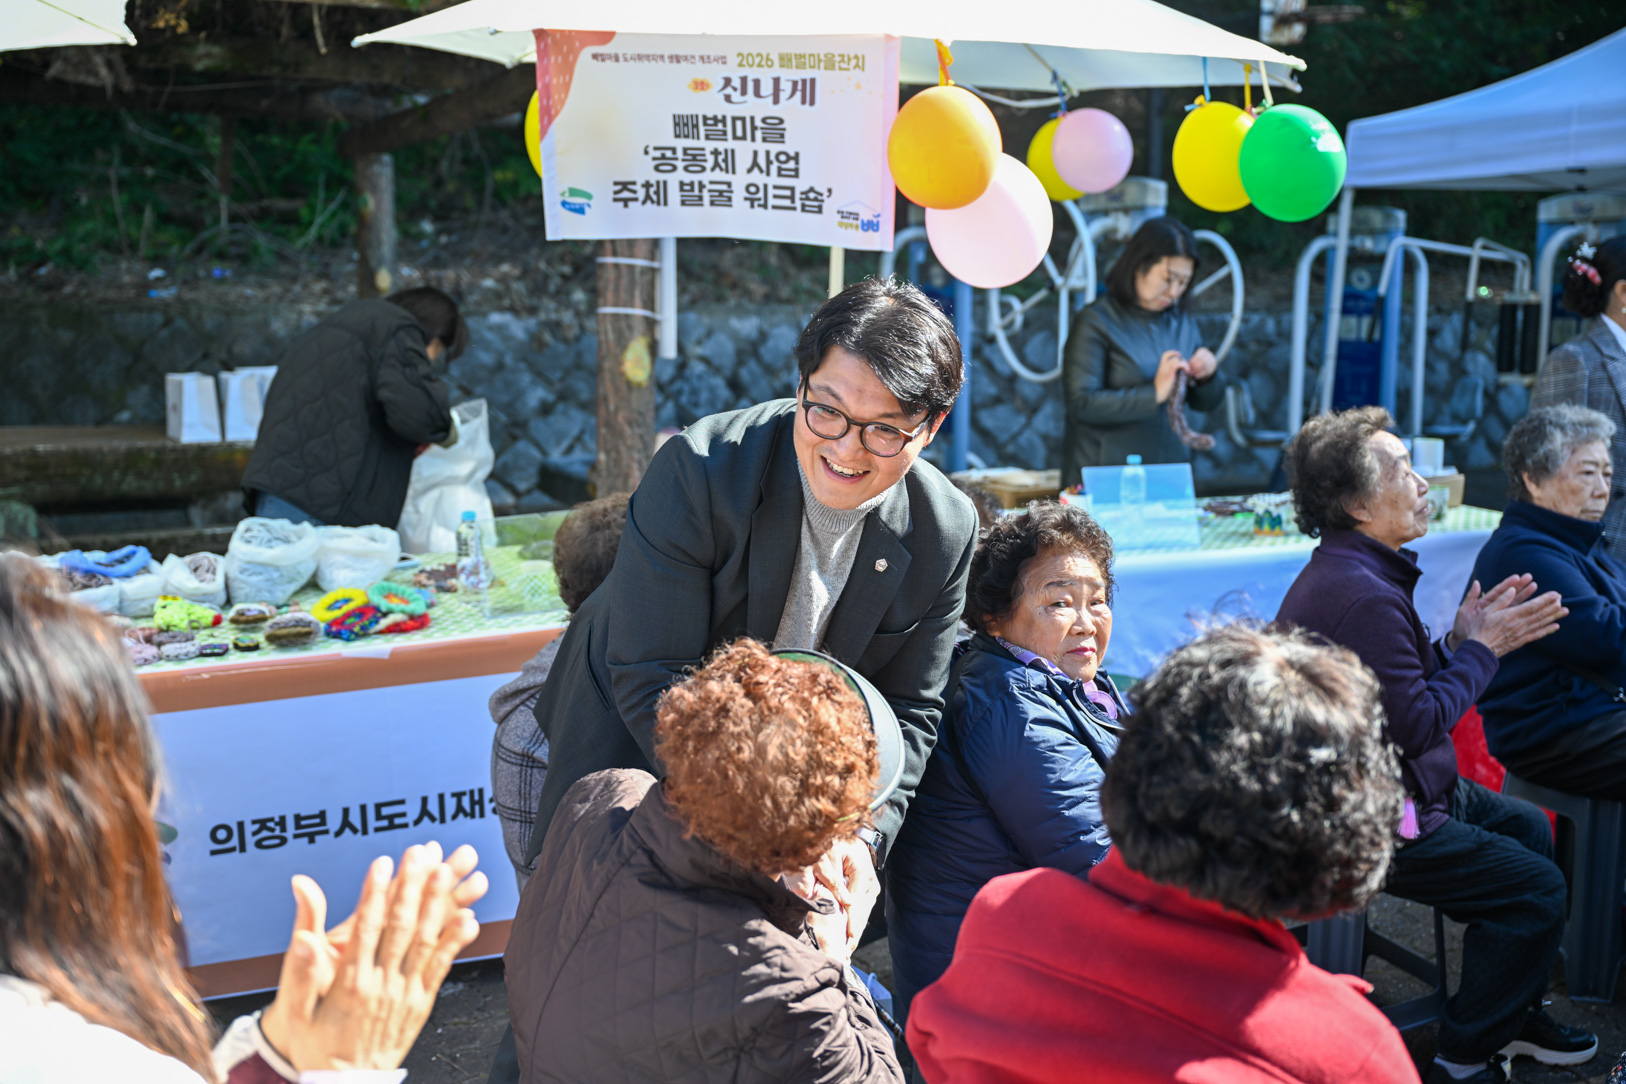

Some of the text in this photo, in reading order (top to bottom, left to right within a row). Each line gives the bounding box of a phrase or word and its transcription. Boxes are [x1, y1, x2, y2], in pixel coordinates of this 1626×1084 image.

[736, 52, 866, 72] 2026 빼벌마을잔치
[717, 75, 816, 107] 신나게
[672, 113, 786, 144] 빼벌마을
[746, 149, 800, 179] 사업
[612, 180, 668, 208] 주체
[678, 180, 734, 208] 발굴
[209, 788, 500, 857] 의정부시도시재
